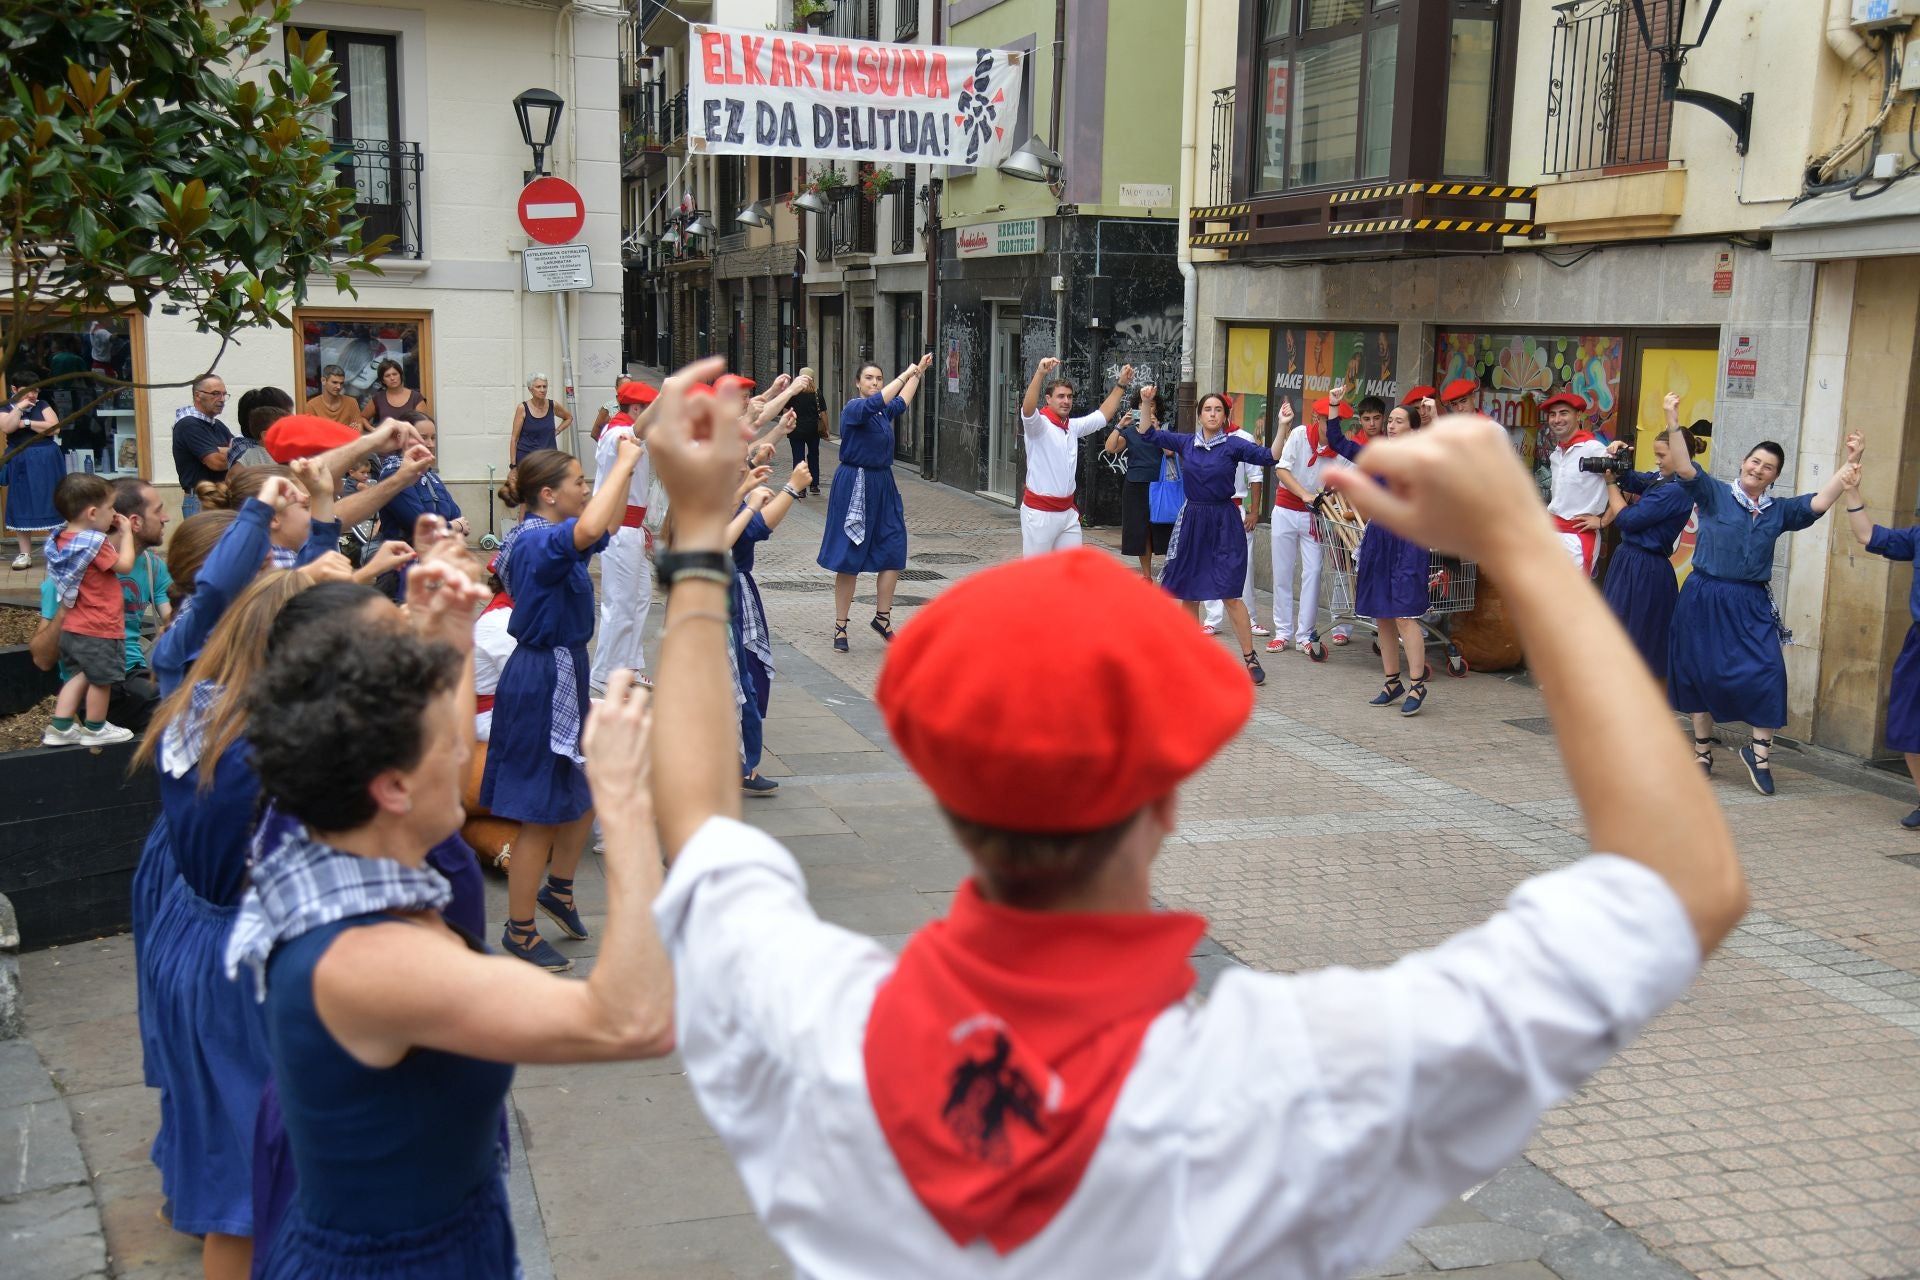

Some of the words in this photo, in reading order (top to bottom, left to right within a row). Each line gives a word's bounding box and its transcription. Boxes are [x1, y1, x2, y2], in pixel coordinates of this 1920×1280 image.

[701, 31, 950, 99] ELKARTASUNA
[703, 97, 745, 145] EZ
[755, 100, 802, 147] DA
[812, 103, 950, 157] DELITUA!
[1274, 373, 1304, 390] MAKE
[1305, 375, 1331, 392] YOUR
[1364, 380, 1397, 398] MAKE
[1729, 361, 1755, 371] Alarma
